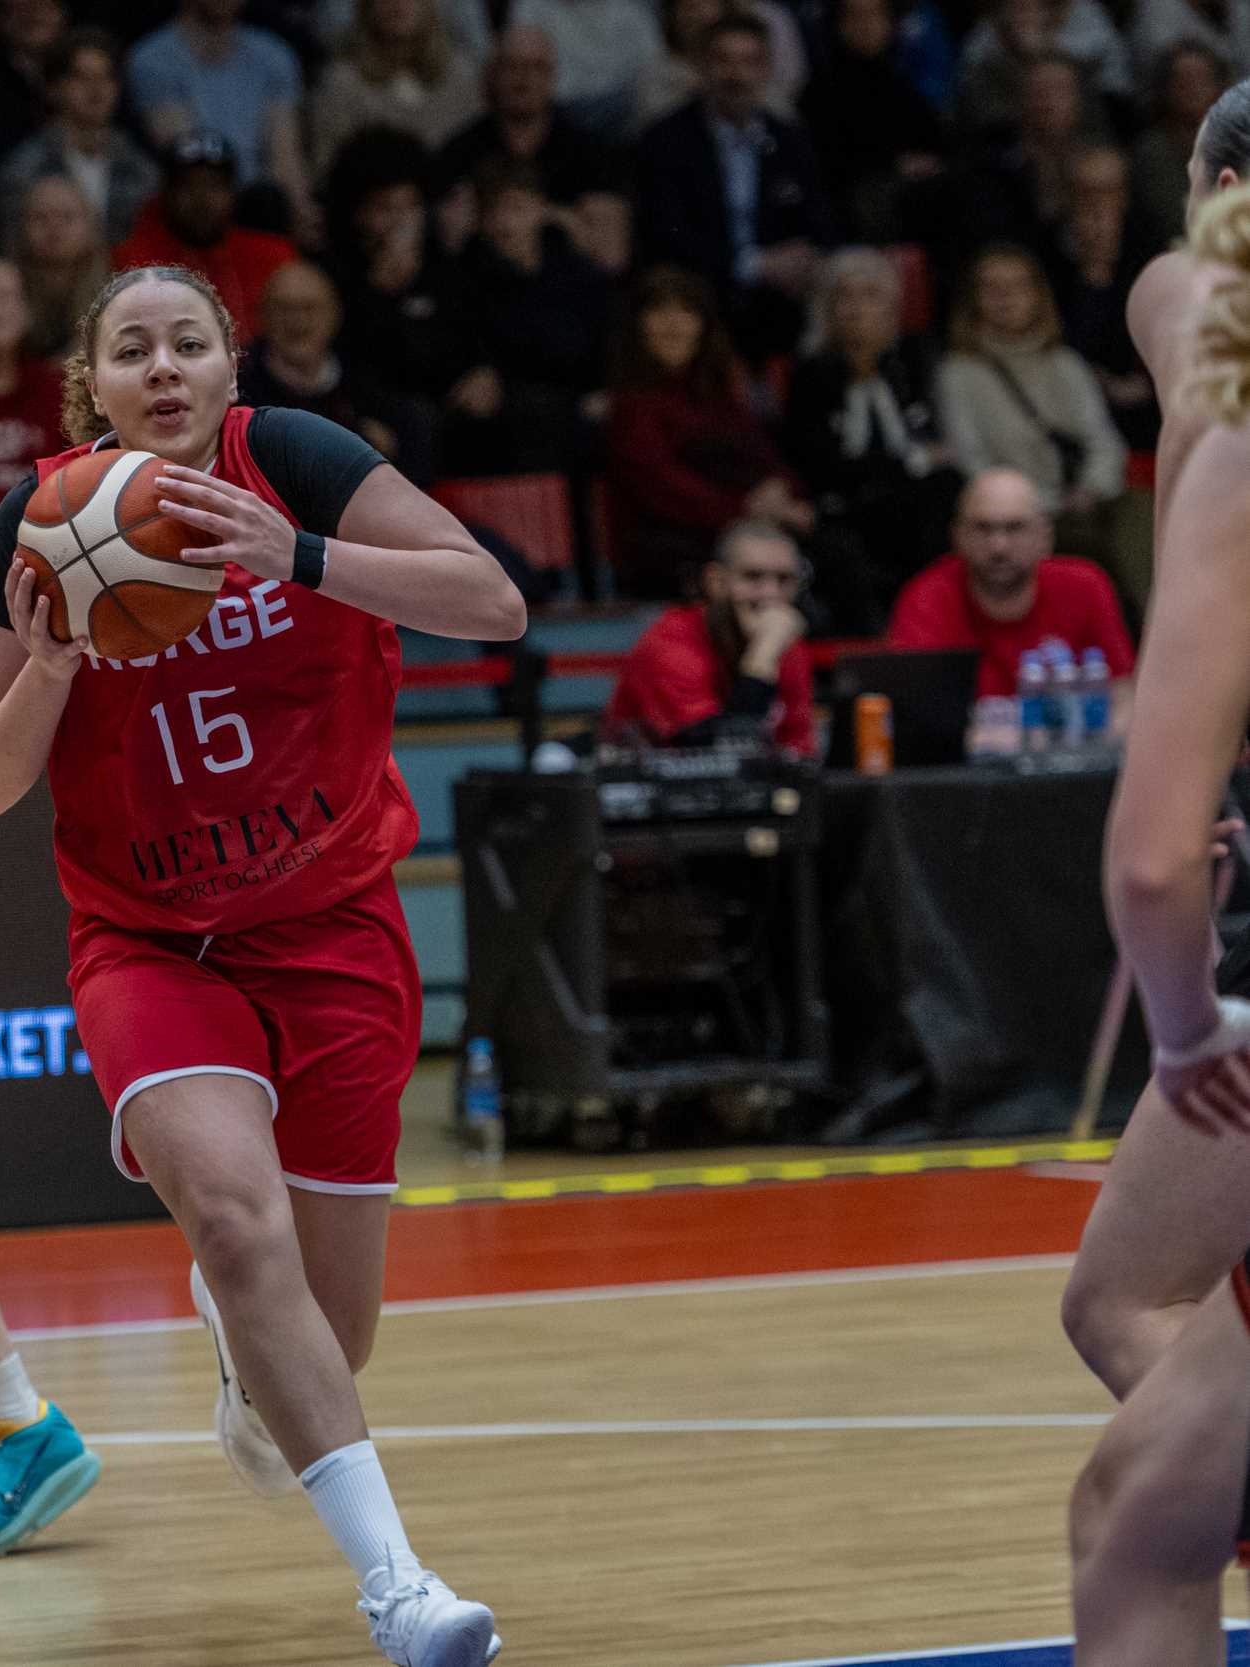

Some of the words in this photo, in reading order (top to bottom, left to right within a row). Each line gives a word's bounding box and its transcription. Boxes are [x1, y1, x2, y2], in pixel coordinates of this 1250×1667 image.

[150, 685, 255, 785] 15
[154, 876, 220, 906] SPORT
[224, 867, 261, 892] OG
[264, 840, 324, 881] HELSE
